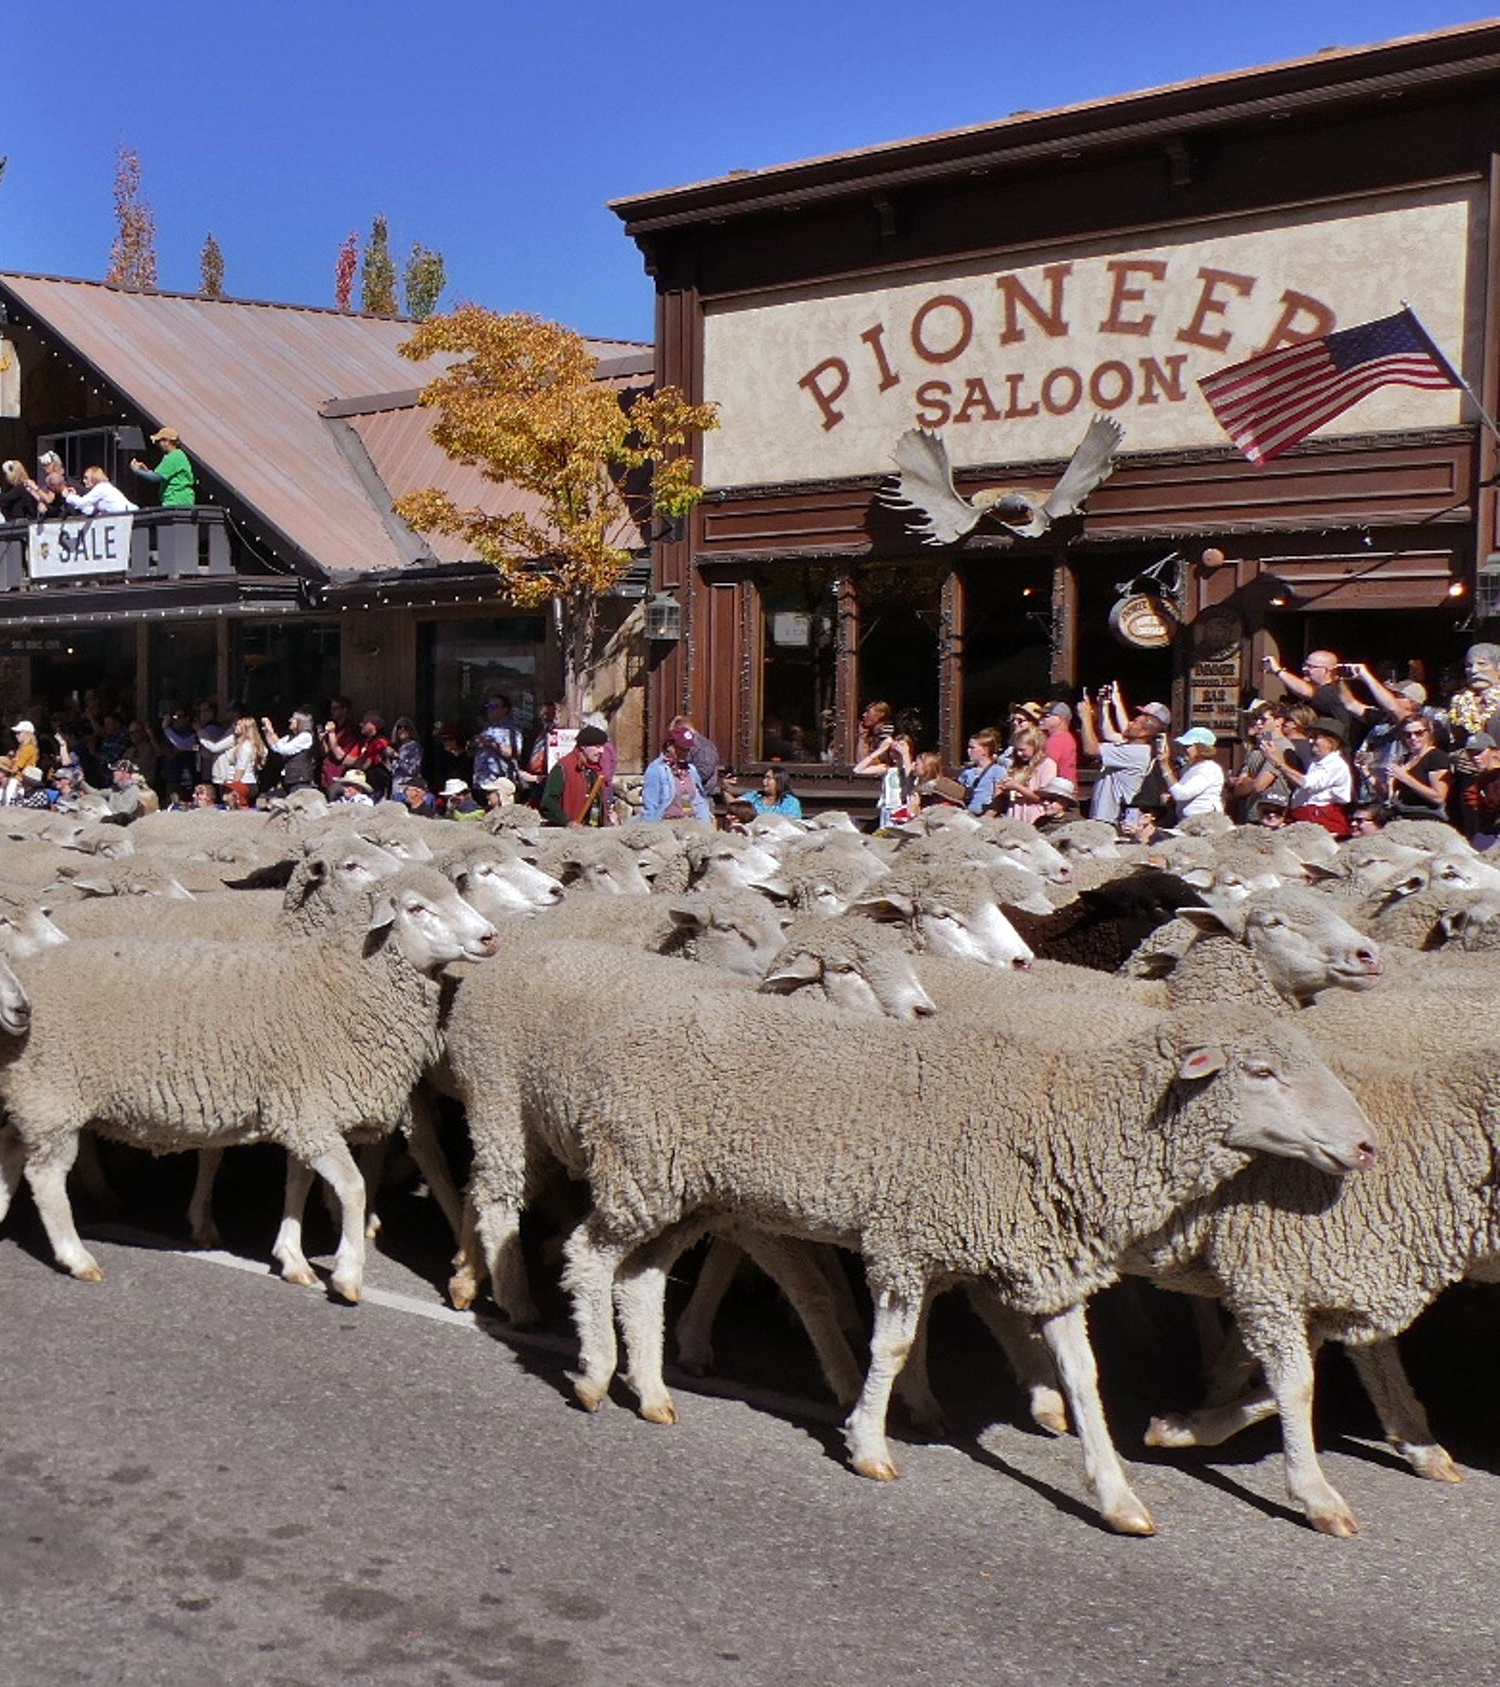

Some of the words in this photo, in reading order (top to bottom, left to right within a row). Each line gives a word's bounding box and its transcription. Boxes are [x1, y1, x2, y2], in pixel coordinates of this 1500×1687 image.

[798, 260, 1337, 432] PIONEER
[916, 354, 1188, 428] SALOON
[59, 525, 117, 563] SALE
